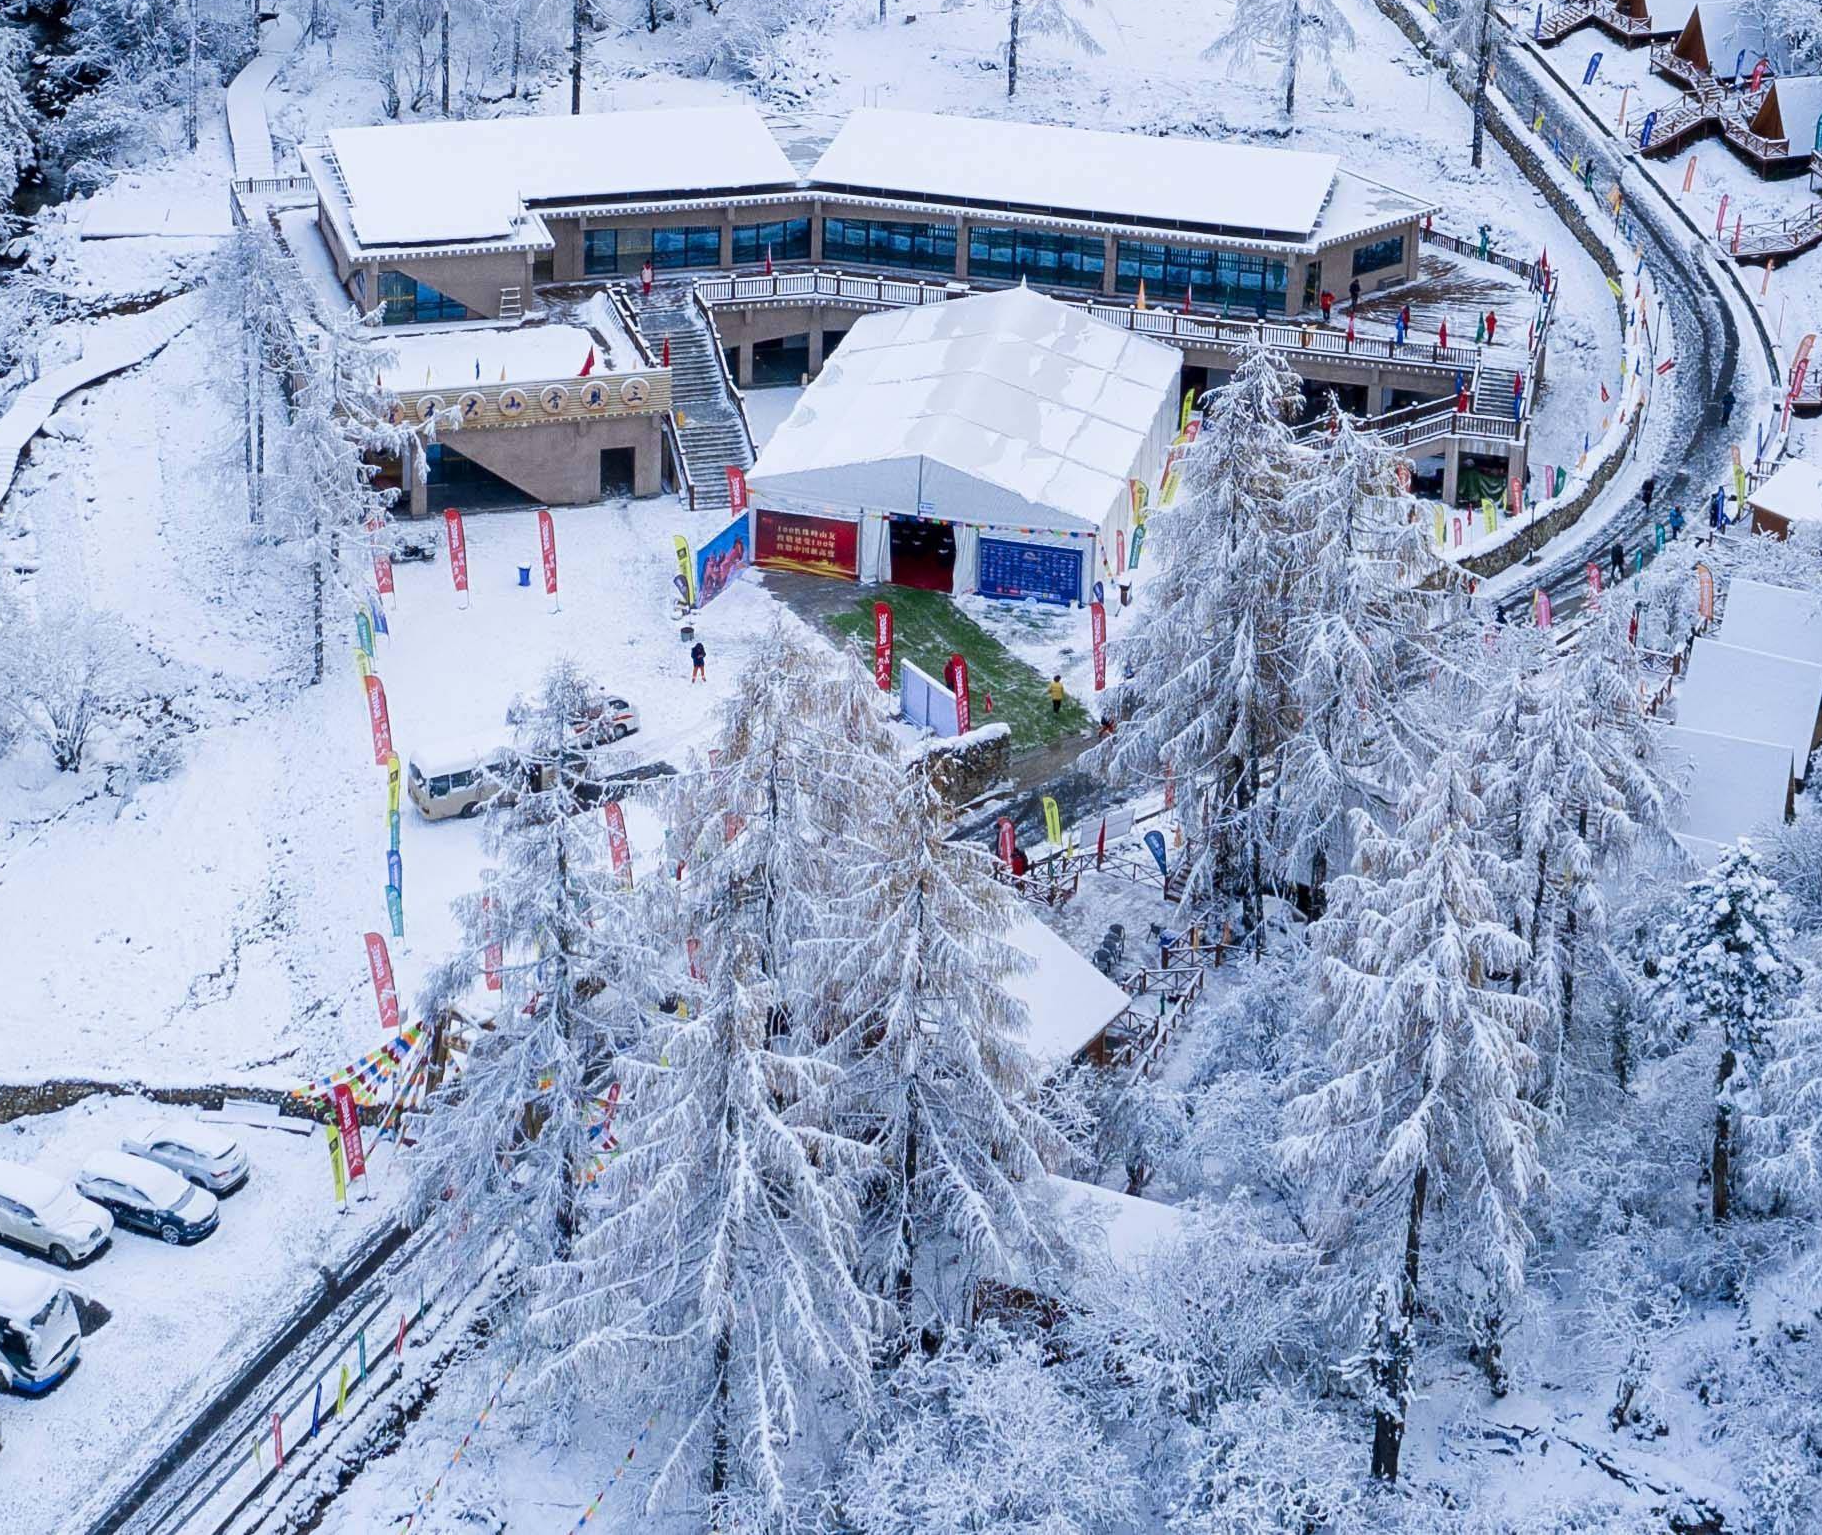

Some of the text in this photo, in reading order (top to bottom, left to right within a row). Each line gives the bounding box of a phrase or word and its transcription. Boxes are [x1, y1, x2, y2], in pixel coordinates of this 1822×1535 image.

[388, 384, 644, 425] 三奥雪山大本
